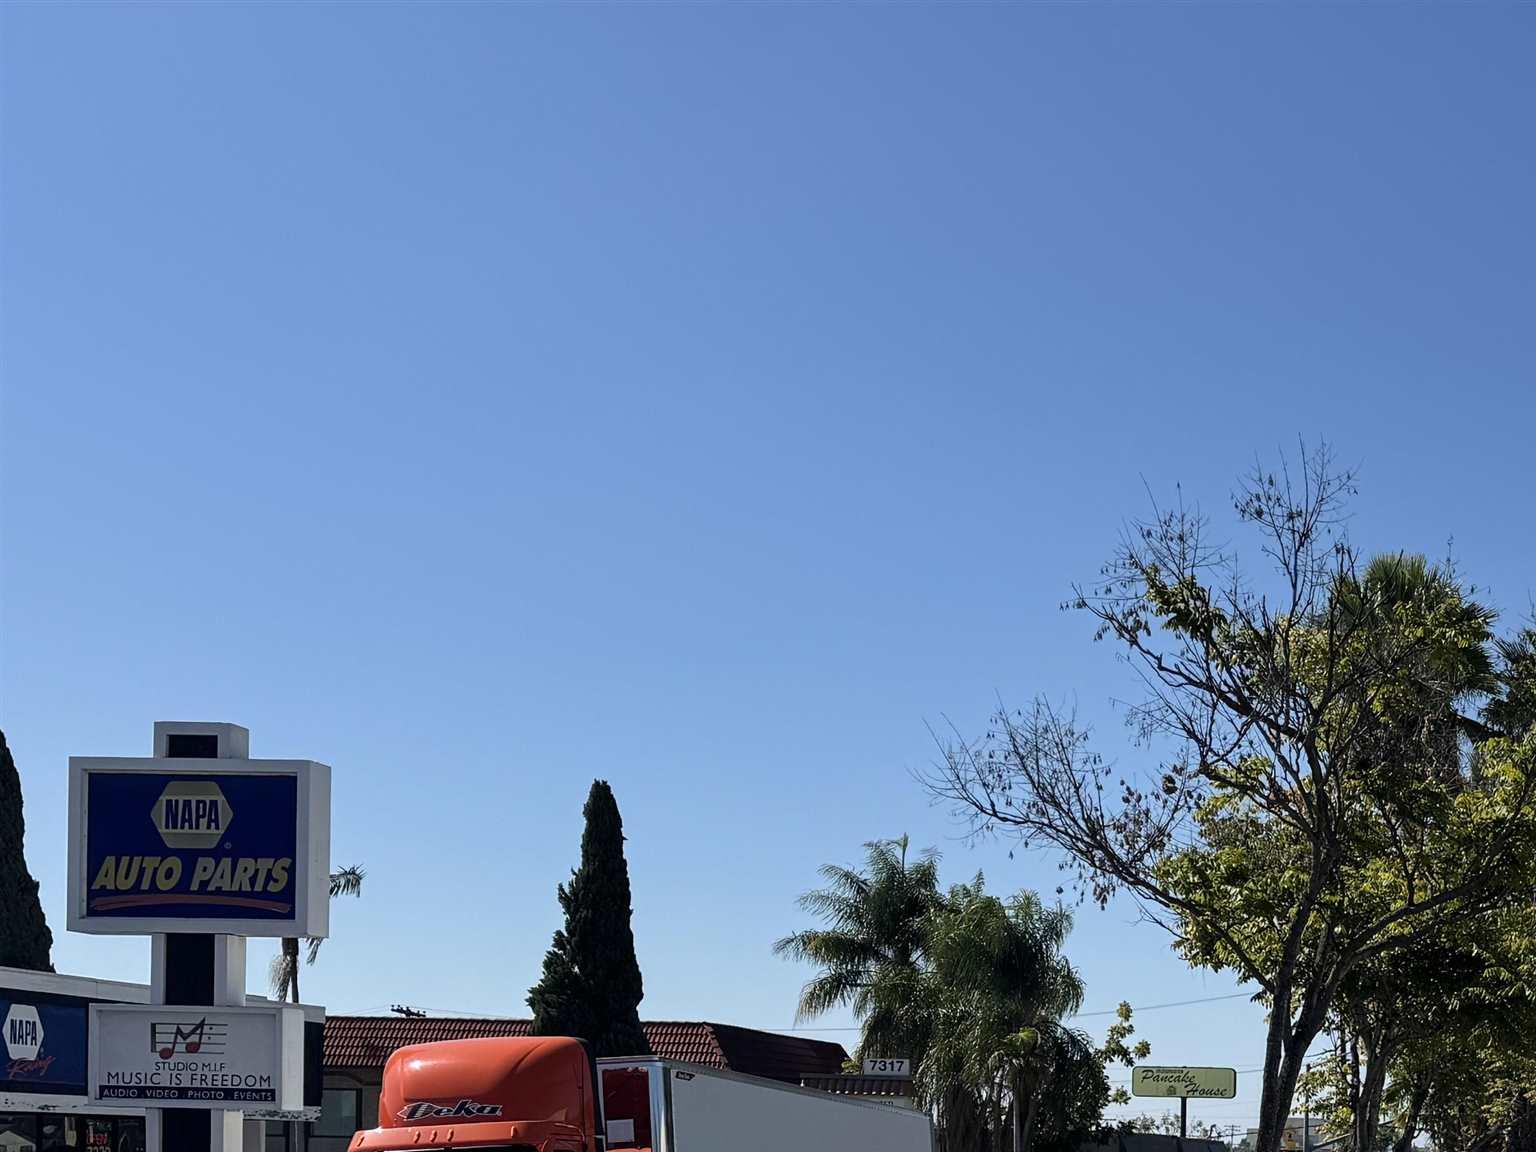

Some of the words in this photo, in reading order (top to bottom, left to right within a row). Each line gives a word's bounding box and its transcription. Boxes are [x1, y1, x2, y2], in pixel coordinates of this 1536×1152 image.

[163, 798, 221, 831] NAPA
[90, 856, 182, 891] AUTO
[189, 857, 292, 892] PARTS
[9, 1018, 38, 1047] NAPA
[155, 1061, 199, 1072] STUDIO
[870, 1060, 905, 1072] 7317
[107, 1071, 161, 1085] MUSIC
[169, 1073, 182, 1086] IS
[190, 1074, 272, 1088] FREEDOM
[1141, 1069, 1196, 1084] Pancake
[102, 1088, 138, 1098] AUDIO
[145, 1089, 179, 1099] VIDEO
[187, 1090, 225, 1100] PHOTO
[233, 1091, 273, 1101] EVENTS
[1184, 1082, 1228, 1097] House
[397, 1099, 503, 1121] Deka
